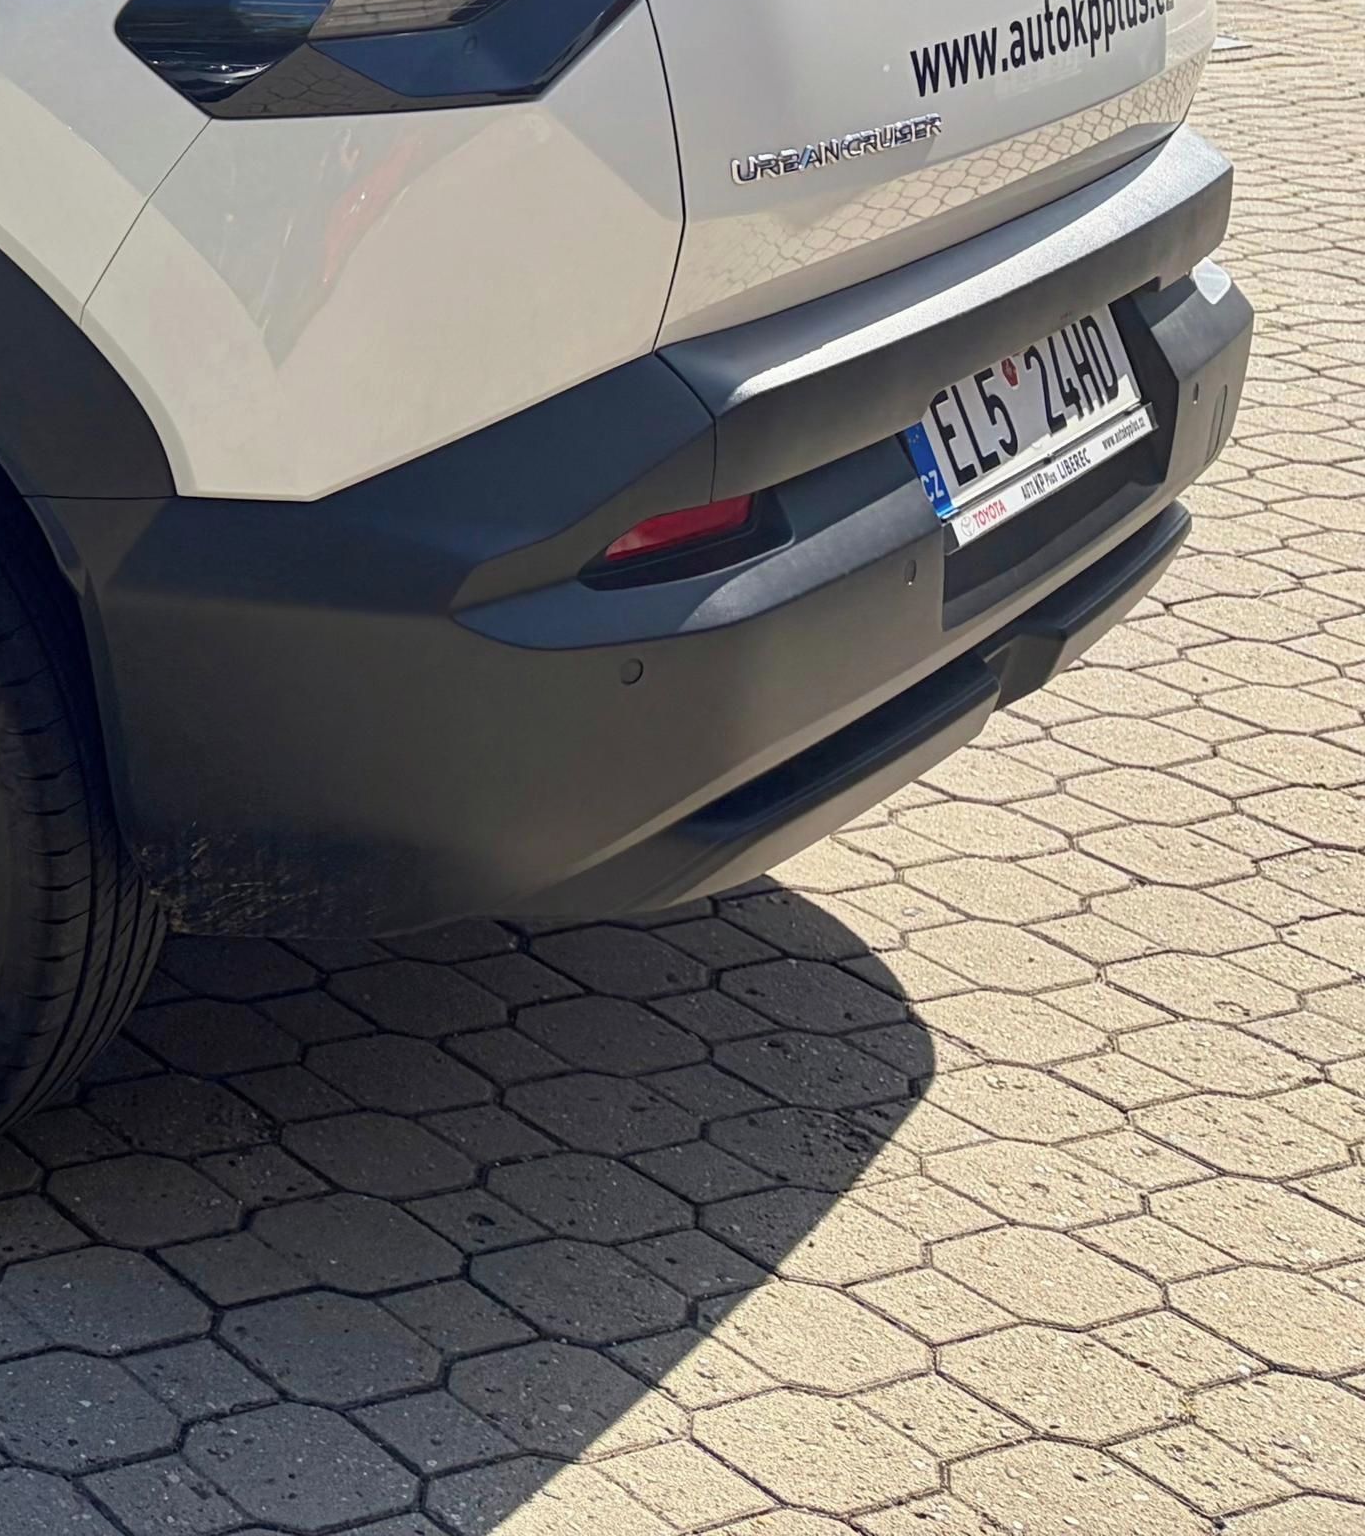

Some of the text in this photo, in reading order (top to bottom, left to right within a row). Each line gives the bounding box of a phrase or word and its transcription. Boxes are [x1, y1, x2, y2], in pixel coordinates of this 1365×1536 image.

[920, 469, 945, 503] CZ
[972, 498, 1007, 529] TOYOTA
[1057, 447, 1092, 480] LIBEREC
